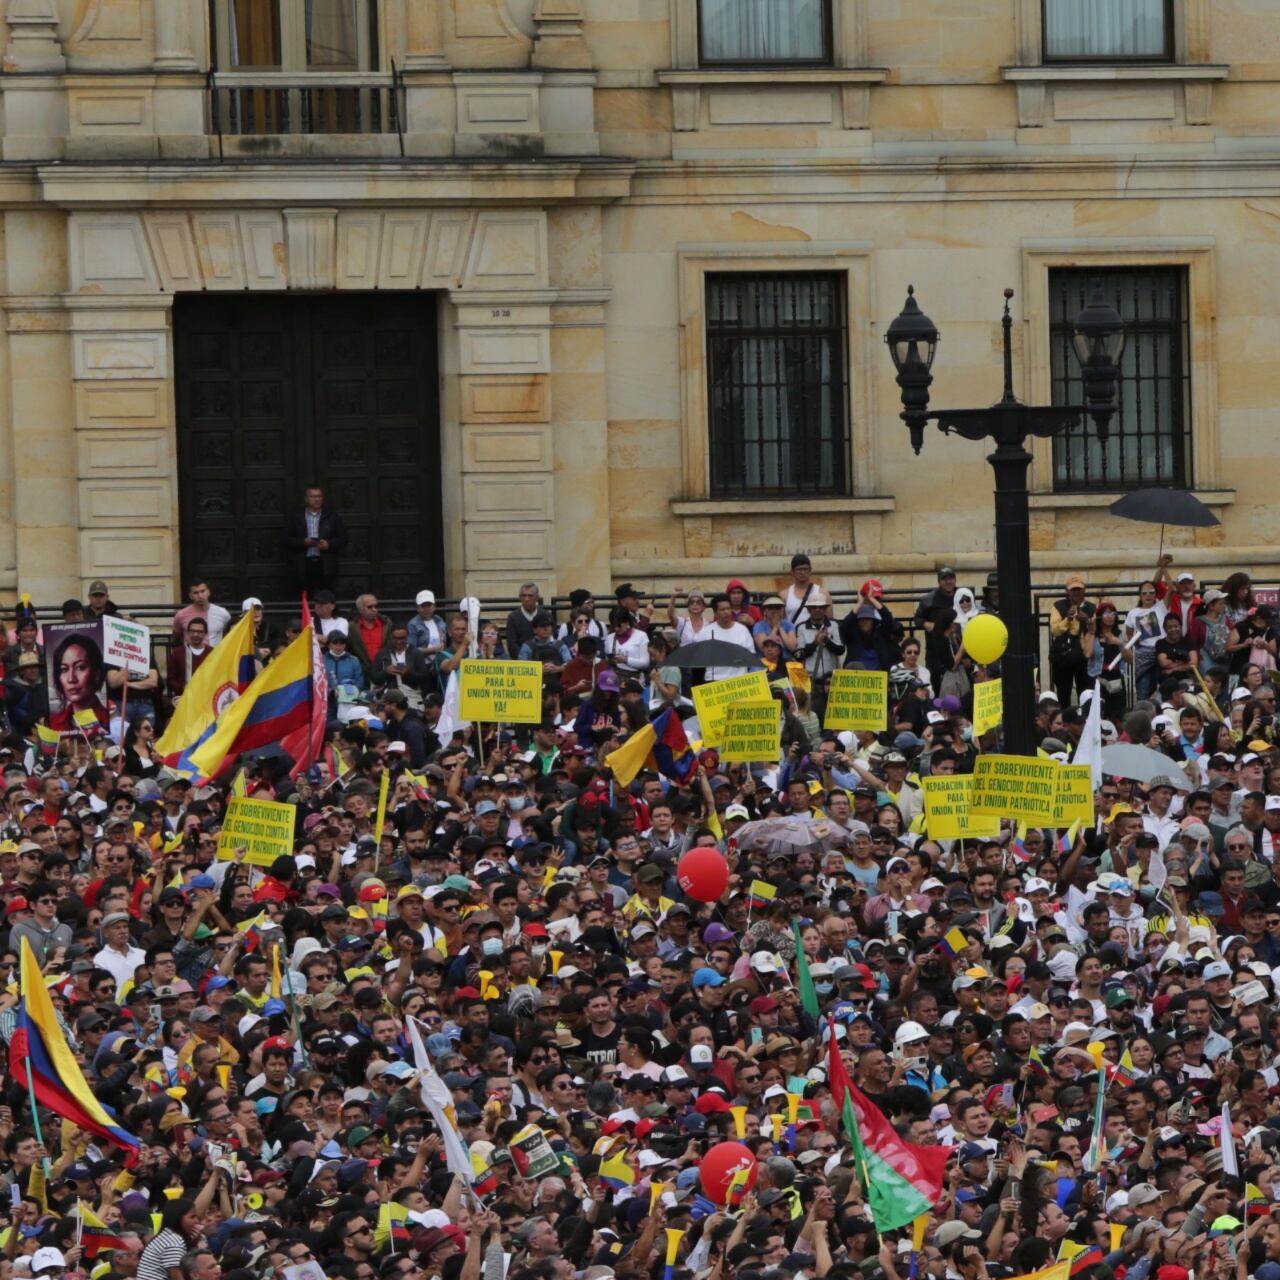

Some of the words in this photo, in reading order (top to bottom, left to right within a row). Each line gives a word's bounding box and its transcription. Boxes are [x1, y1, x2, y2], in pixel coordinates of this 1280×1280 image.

[505, 665, 538, 677] INTEGRAL
[485, 677, 505, 687] PARA
[507, 678, 516, 688] LA
[493, 701, 507, 713] YA!
[735, 706, 776, 721] SOBREVIVIENTE
[731, 724, 757, 737] GENOCIDIO
[978, 762, 991, 774] SOY
[995, 762, 1053, 780] SOBREVIVIENTE
[974, 778, 985, 790] DEL
[988, 779, 1024, 794] GENOCIDIO
[1026, 781, 1052, 796] CONTRA
[973, 794, 981, 807] LA
[240, 802, 291, 821] SOBREVIVIENTE
[234, 821, 265, 836] GENOCIDIO
